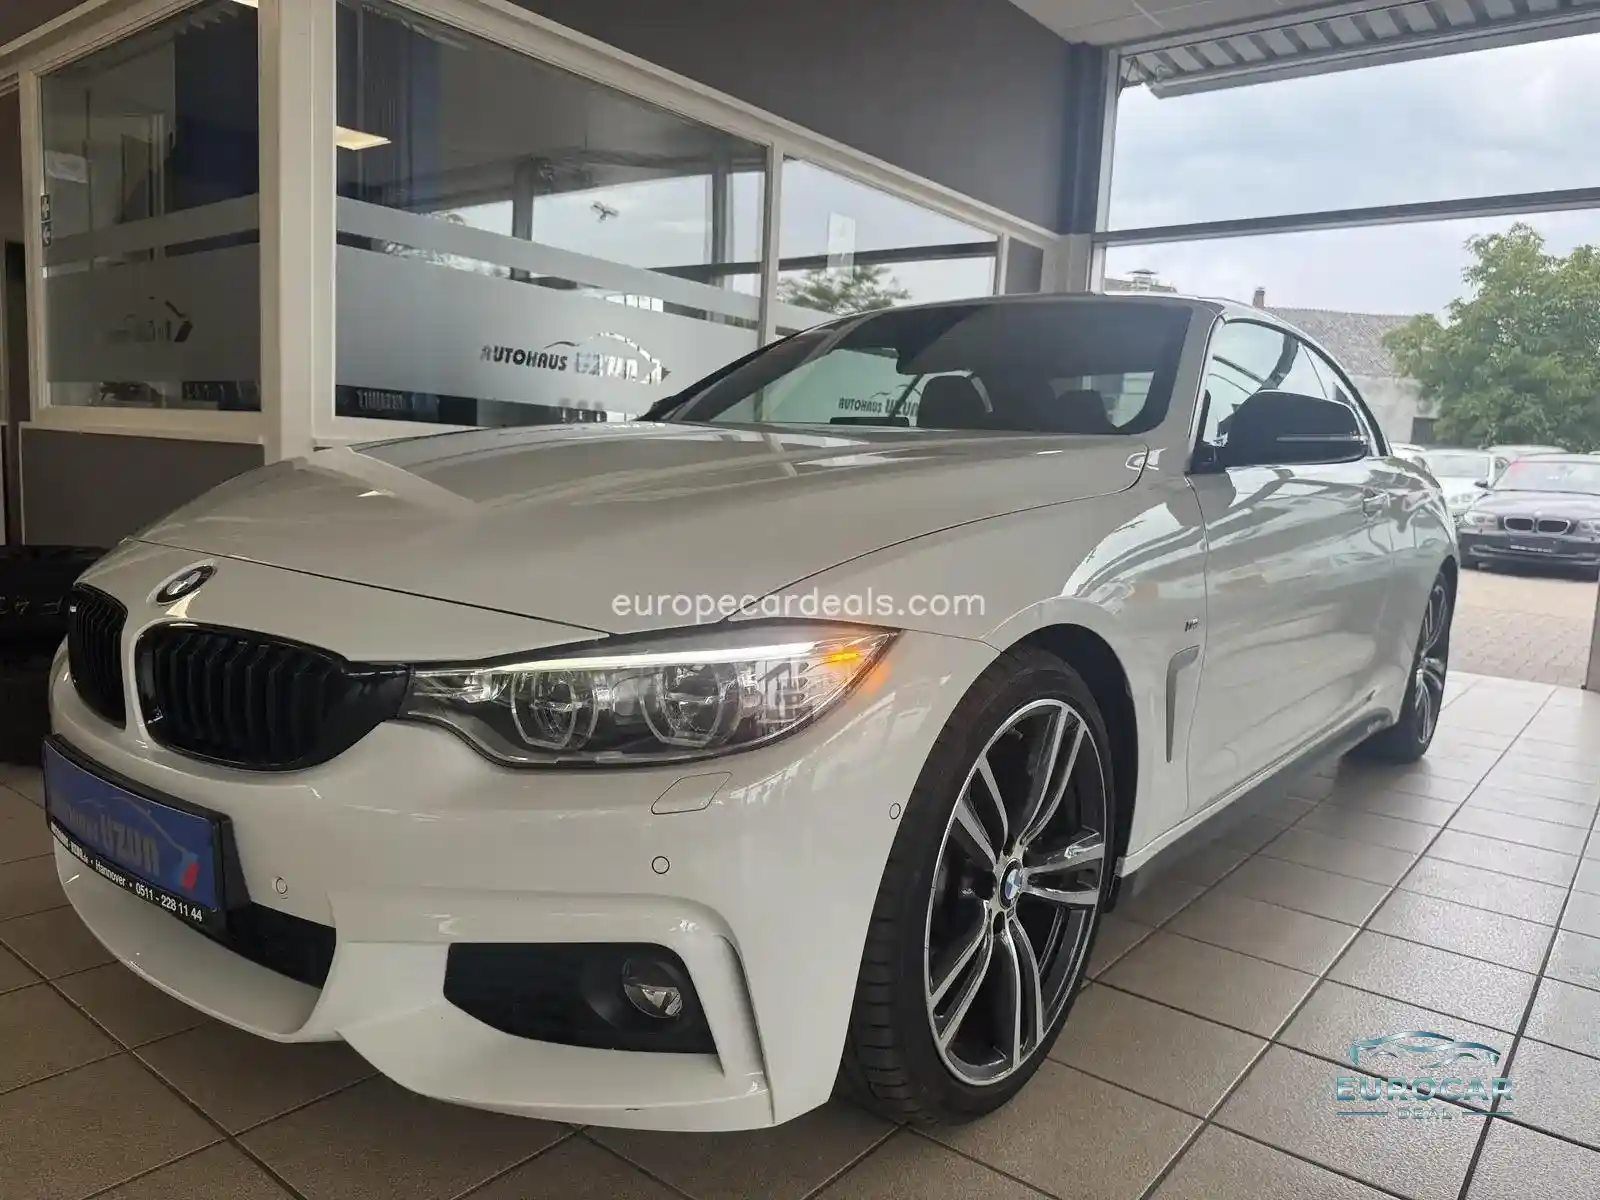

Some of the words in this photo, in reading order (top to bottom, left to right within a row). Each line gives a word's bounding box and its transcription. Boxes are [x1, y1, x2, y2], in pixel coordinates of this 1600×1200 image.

[480, 344, 568, 371] AUTOHAUS
[95, 859, 126, 887] Hannover
[135, 882, 154, 901] 0511
[161, 894, 177, 912] 228
[178, 902, 189, 917] 11
[191, 907, 203, 922] 44
